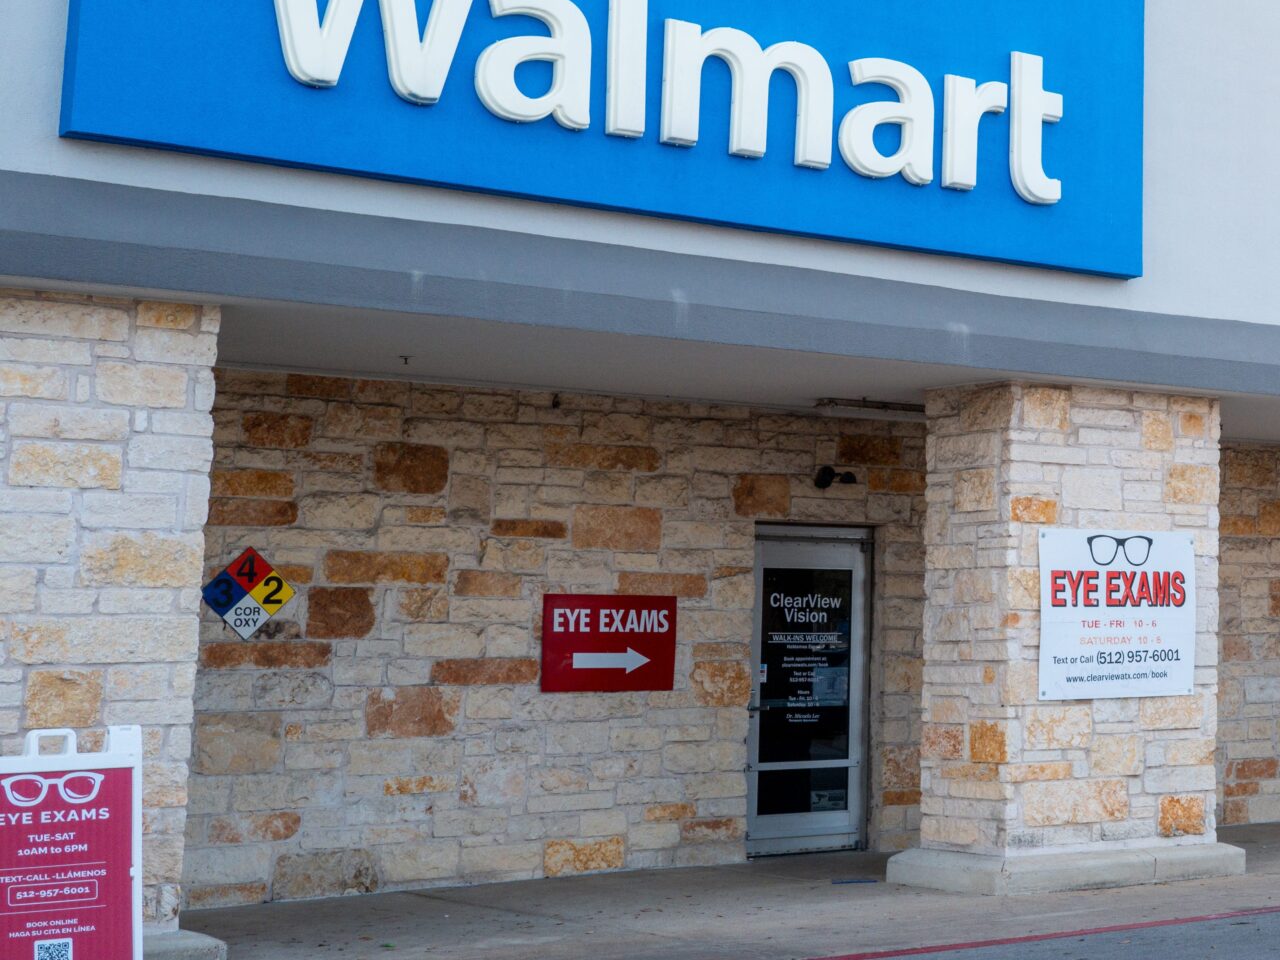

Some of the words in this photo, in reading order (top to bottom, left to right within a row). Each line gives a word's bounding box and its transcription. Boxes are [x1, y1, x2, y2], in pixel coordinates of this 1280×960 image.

[236, 554, 258, 583] 4
[211, 577, 233, 608] 3
[262, 576, 283, 604] 2
[1050, 570, 1099, 607] EYE
[1105, 570, 1186, 607] EXAMS
[769, 592, 842, 608] ClearView
[234, 607, 260, 617] COR
[784, 608, 828, 623] Vision
[234, 618, 259, 628] OXY
[553, 608, 591, 632] EYE
[599, 608, 669, 633] EXAMS
[1081, 620, 1101, 628] TUE
[1109, 620, 1125, 628] FRI
[1134, 620, 1143, 628] 10
[772, 634, 804, 642] WALK-INS
[805, 634, 838, 642] WELCOME
[1079, 636, 1133, 645] SATURDAY
[1138, 636, 1148, 644] 10
[1052, 656, 1068, 665] Text
[1079, 655, 1094, 663] Call
[1096, 650, 1125, 666] (512)
[1127, 648, 1181, 663] 957-6001
[41, 807, 110, 824] EXAMS
[27, 832, 76, 843] TUE-SAT
[17, 847, 47, 856] 10AM
[50, 846, 62, 854] to
[64, 844, 88, 853] 6PM
[0, 874, 51, 883] TEXT-CALL
[16, 886, 90, 900] 512-957-6001
[49, 918, 78, 926] ONLINE
